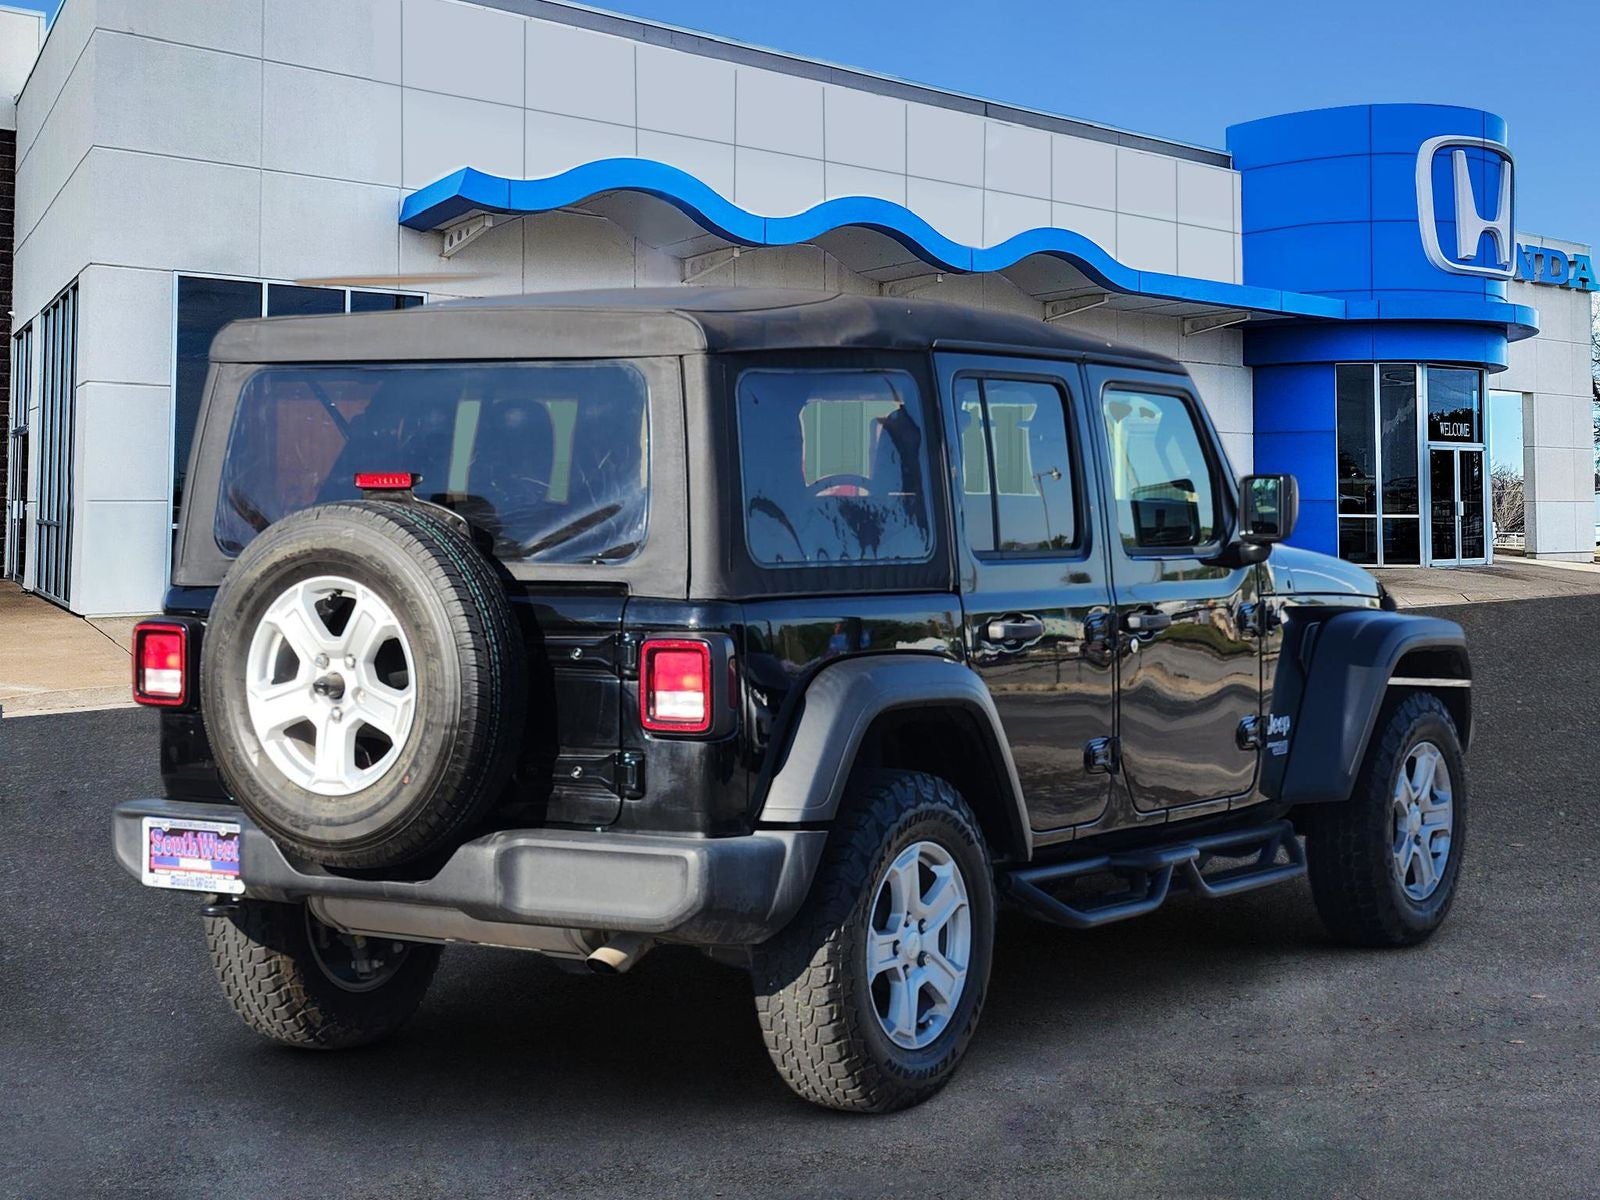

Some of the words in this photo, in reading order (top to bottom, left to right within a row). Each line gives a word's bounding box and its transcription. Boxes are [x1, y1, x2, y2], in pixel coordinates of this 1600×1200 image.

[1440, 422, 1471, 437] WELCOME
[1267, 713, 1290, 737] Jeep
[897, 809, 975, 847] MOUNTAIN
[150, 828, 240, 863] SouthWest
